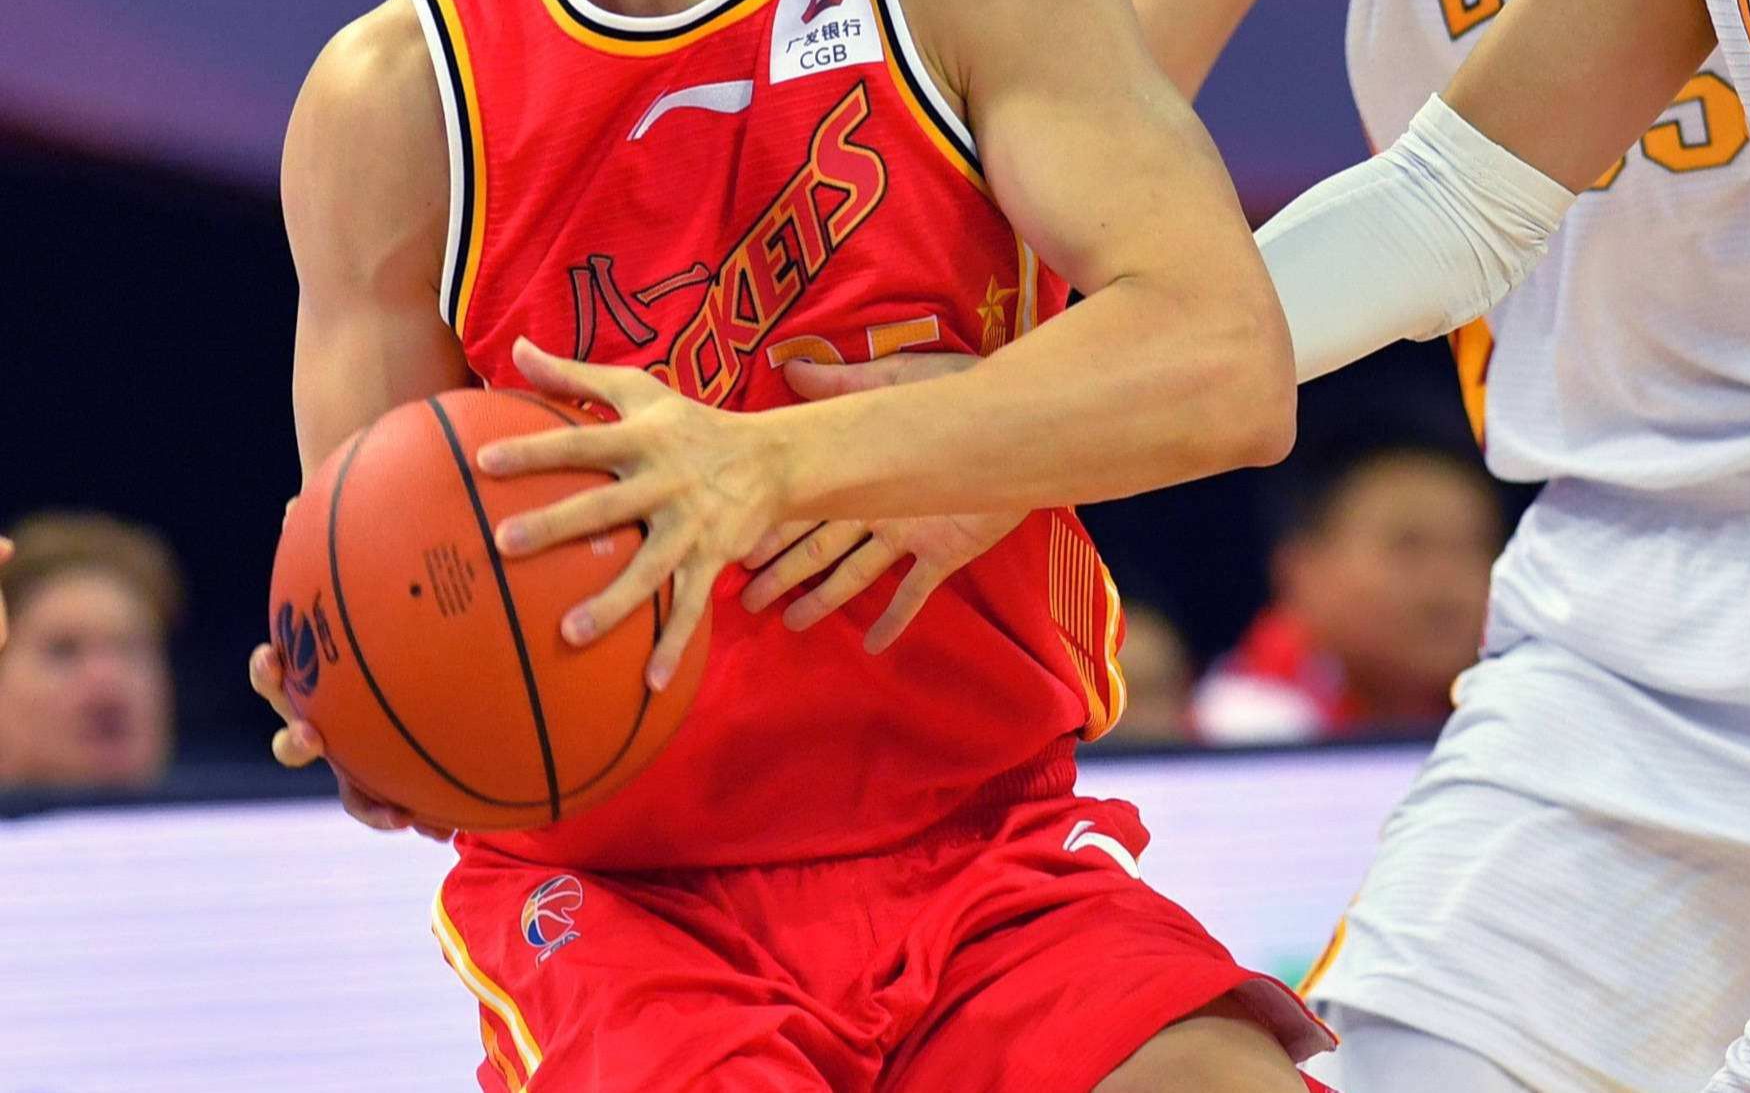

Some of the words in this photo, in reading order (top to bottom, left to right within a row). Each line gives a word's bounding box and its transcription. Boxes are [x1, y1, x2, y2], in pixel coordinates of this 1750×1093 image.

[786, 18, 862, 54] 广发银行
[799, 44, 848, 70] CGB
